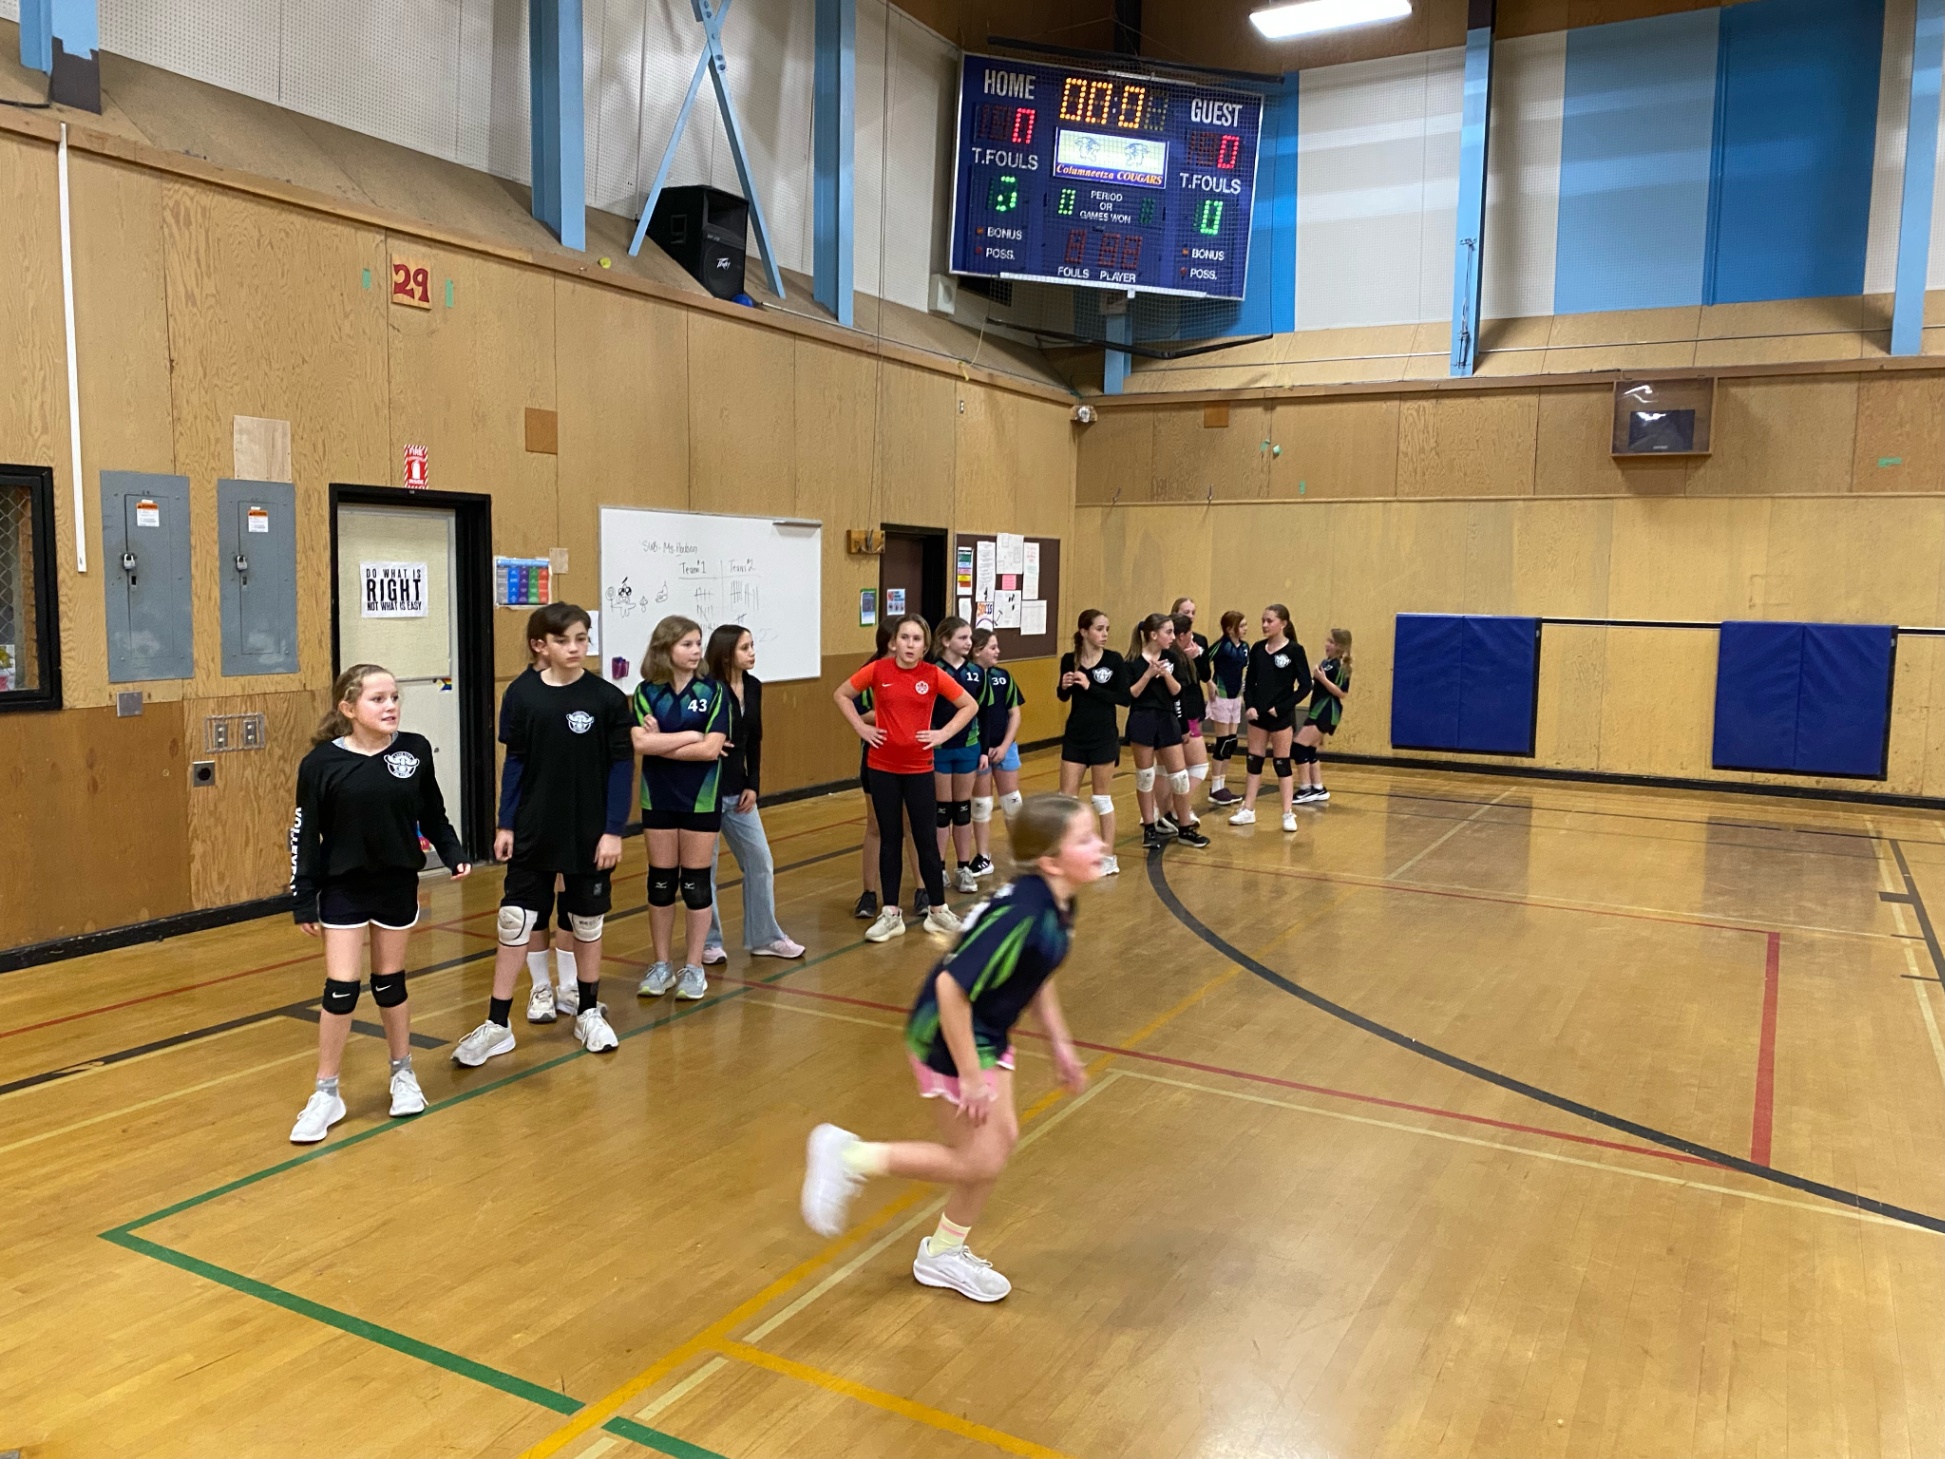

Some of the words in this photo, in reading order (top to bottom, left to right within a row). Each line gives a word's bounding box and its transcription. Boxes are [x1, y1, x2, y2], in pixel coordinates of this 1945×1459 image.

[984, 69, 1036, 99] HOME
[1191, 98, 1243, 127] GUEST
[971, 147, 1039, 170] T.FOULS
[1217, 134, 1240, 169] 0
[1056, 163, 1114, 180] Columneetza
[1117, 170, 1164, 185] COUGARS
[1179, 172, 1242, 195] T.FOULS
[1090, 190, 1123, 202] PERIOD
[1099, 202, 1113, 211] OR
[1079, 210, 1109, 222] GAMES
[1110, 213, 1131, 224] WON
[987, 226, 1022, 240] BONUS
[985, 247, 1015, 260] POSS.
[1191, 248, 1225, 261] BONUS
[1057, 266, 1090, 279] FOULS
[1099, 270, 1136, 283] PLAYER
[1189, 268, 1218, 280] POSS.
[392, 263, 430, 303] 29
[366, 568, 377, 578] DO
[383, 568, 407, 578] WHAT
[413, 568, 421, 578] IS
[679, 561, 699, 574] Team
[366, 578, 421, 602] RIGHT
[367, 601, 378, 611] NOT
[381, 601, 397, 611] WHAT
[399, 601, 406, 611] IS
[407, 601, 422, 611] EASY
[966, 671, 980, 682] 12
[991, 676, 1007, 686] 30
[687, 698, 708, 712] 43
